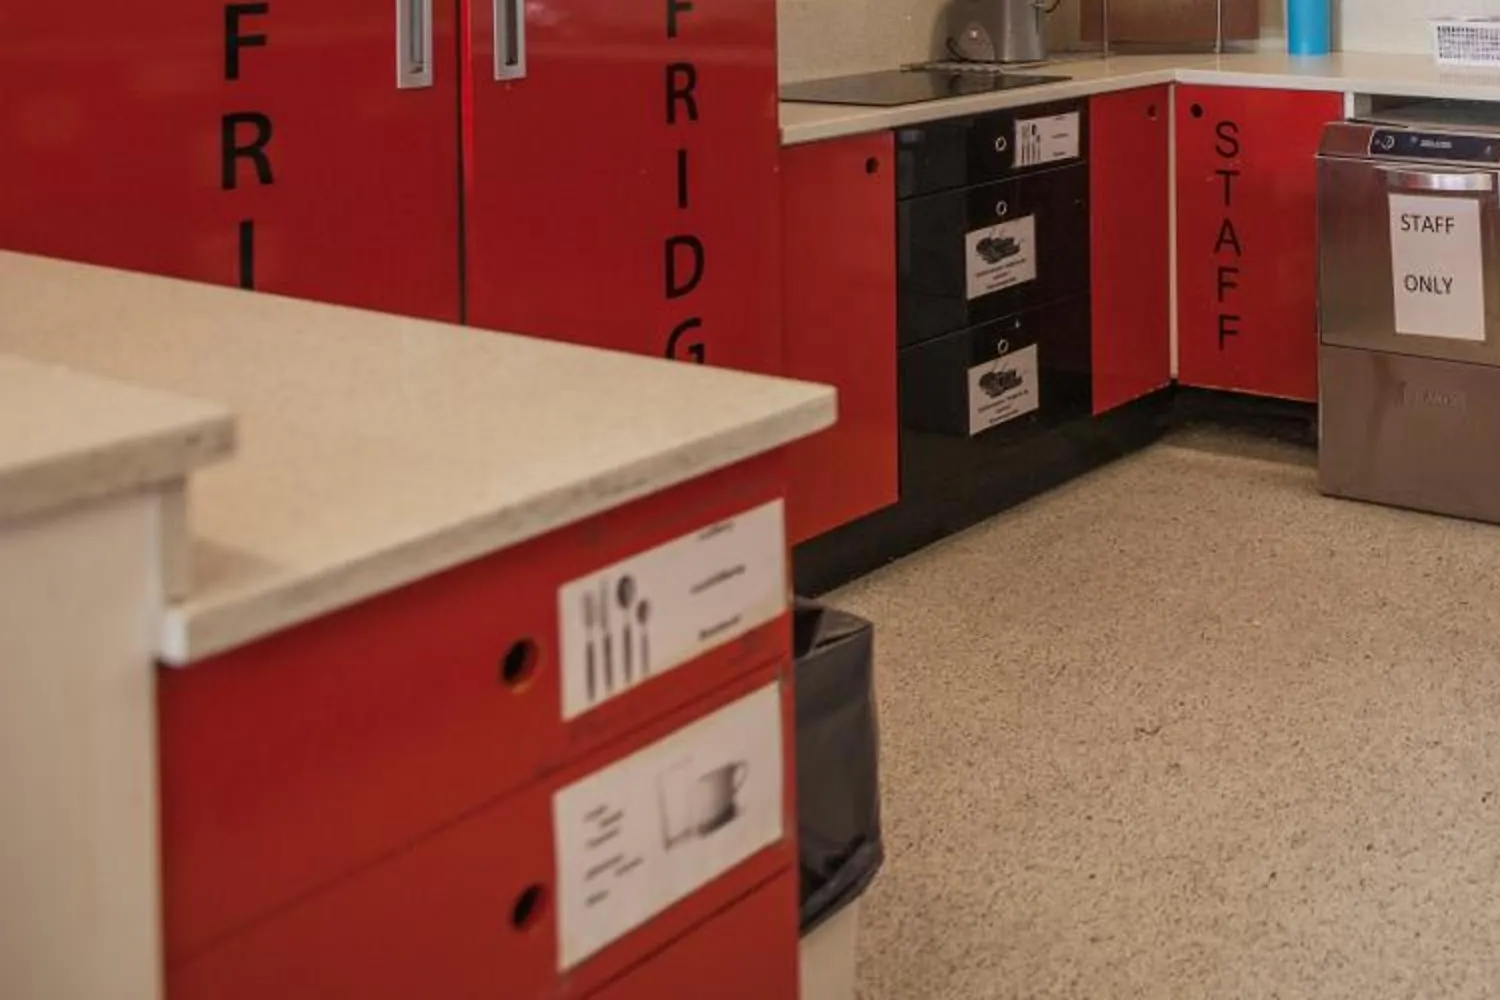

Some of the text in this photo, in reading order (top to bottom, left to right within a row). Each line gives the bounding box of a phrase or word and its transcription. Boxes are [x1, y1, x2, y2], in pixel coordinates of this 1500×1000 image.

[1400, 212, 1456, 235] STAFF
[1213, 120, 1242, 351] STAFF
[1403, 274, 1454, 296] ONLY
